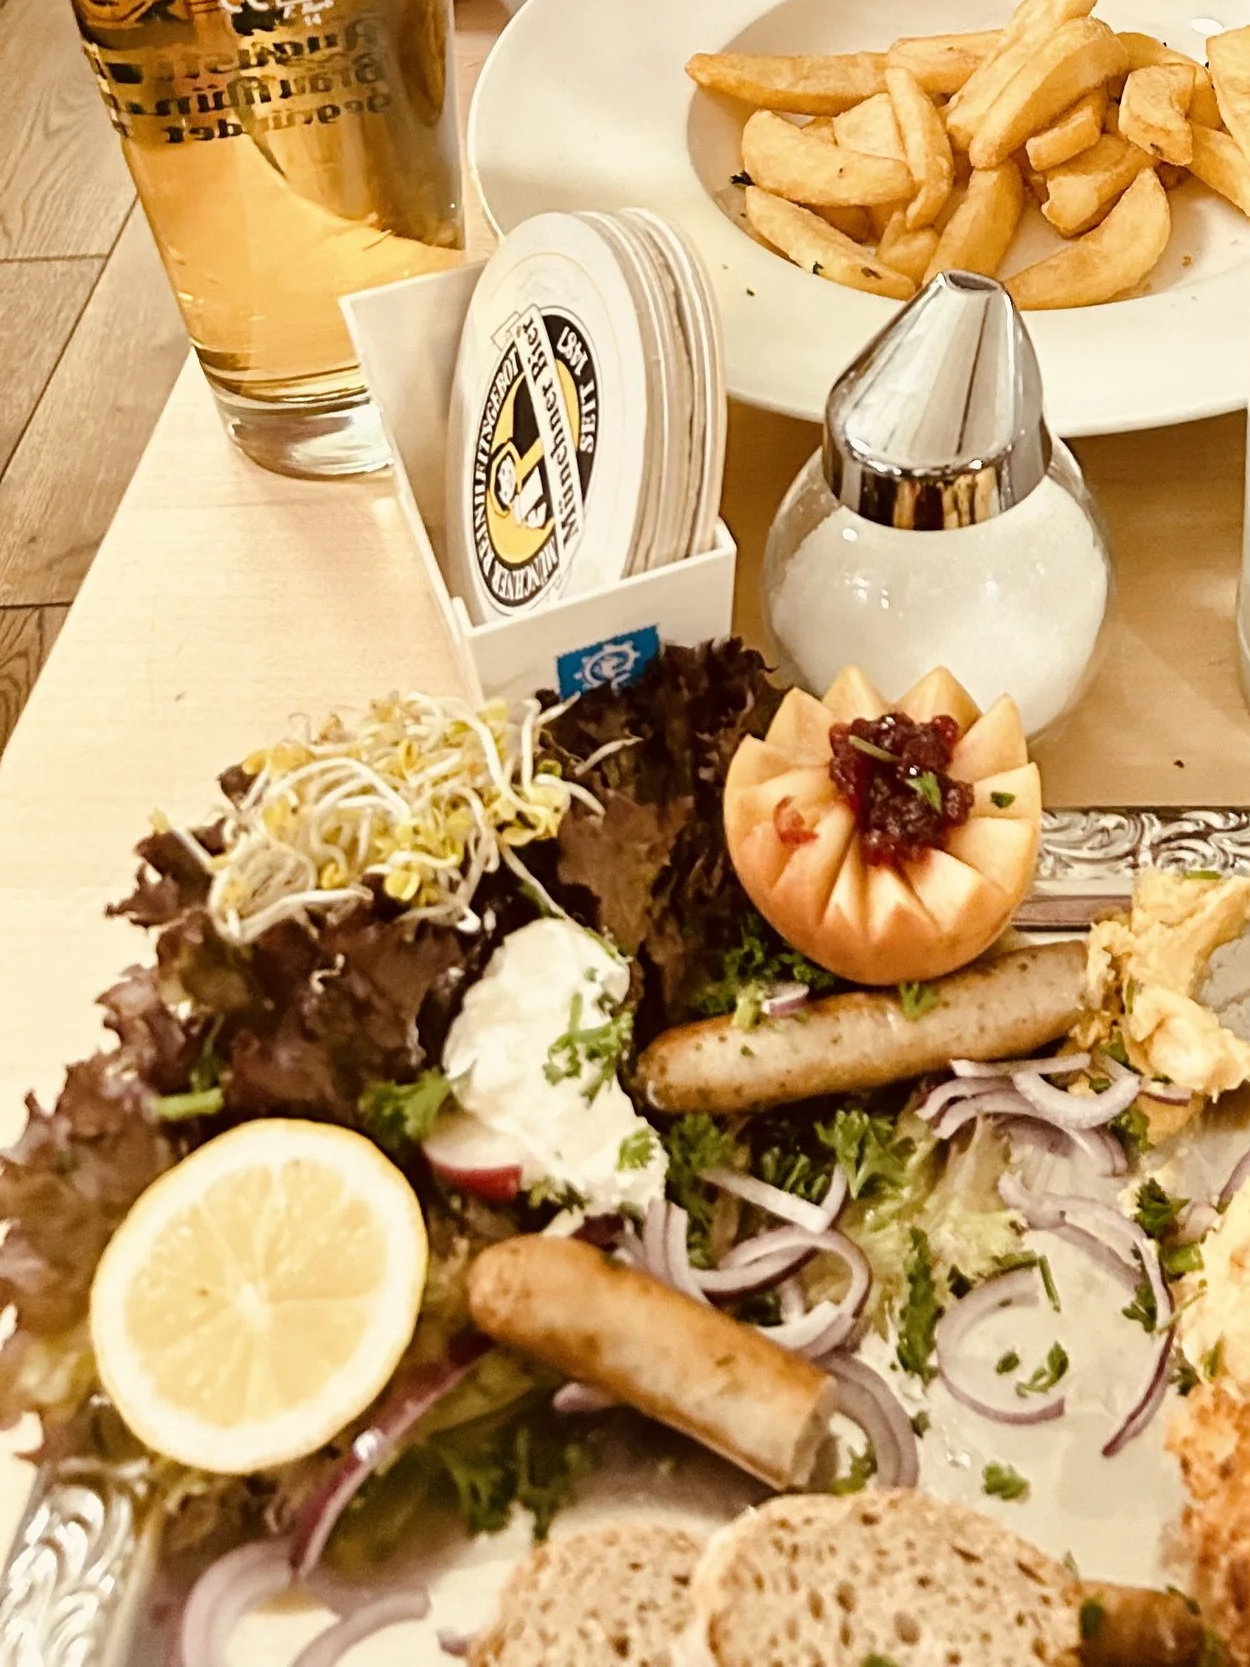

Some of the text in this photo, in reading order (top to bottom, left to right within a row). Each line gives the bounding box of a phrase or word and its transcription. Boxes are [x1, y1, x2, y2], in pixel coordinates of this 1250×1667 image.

[522, 316, 579, 550] Münchner Bier
[557, 326, 596, 453] SEIT 1487
